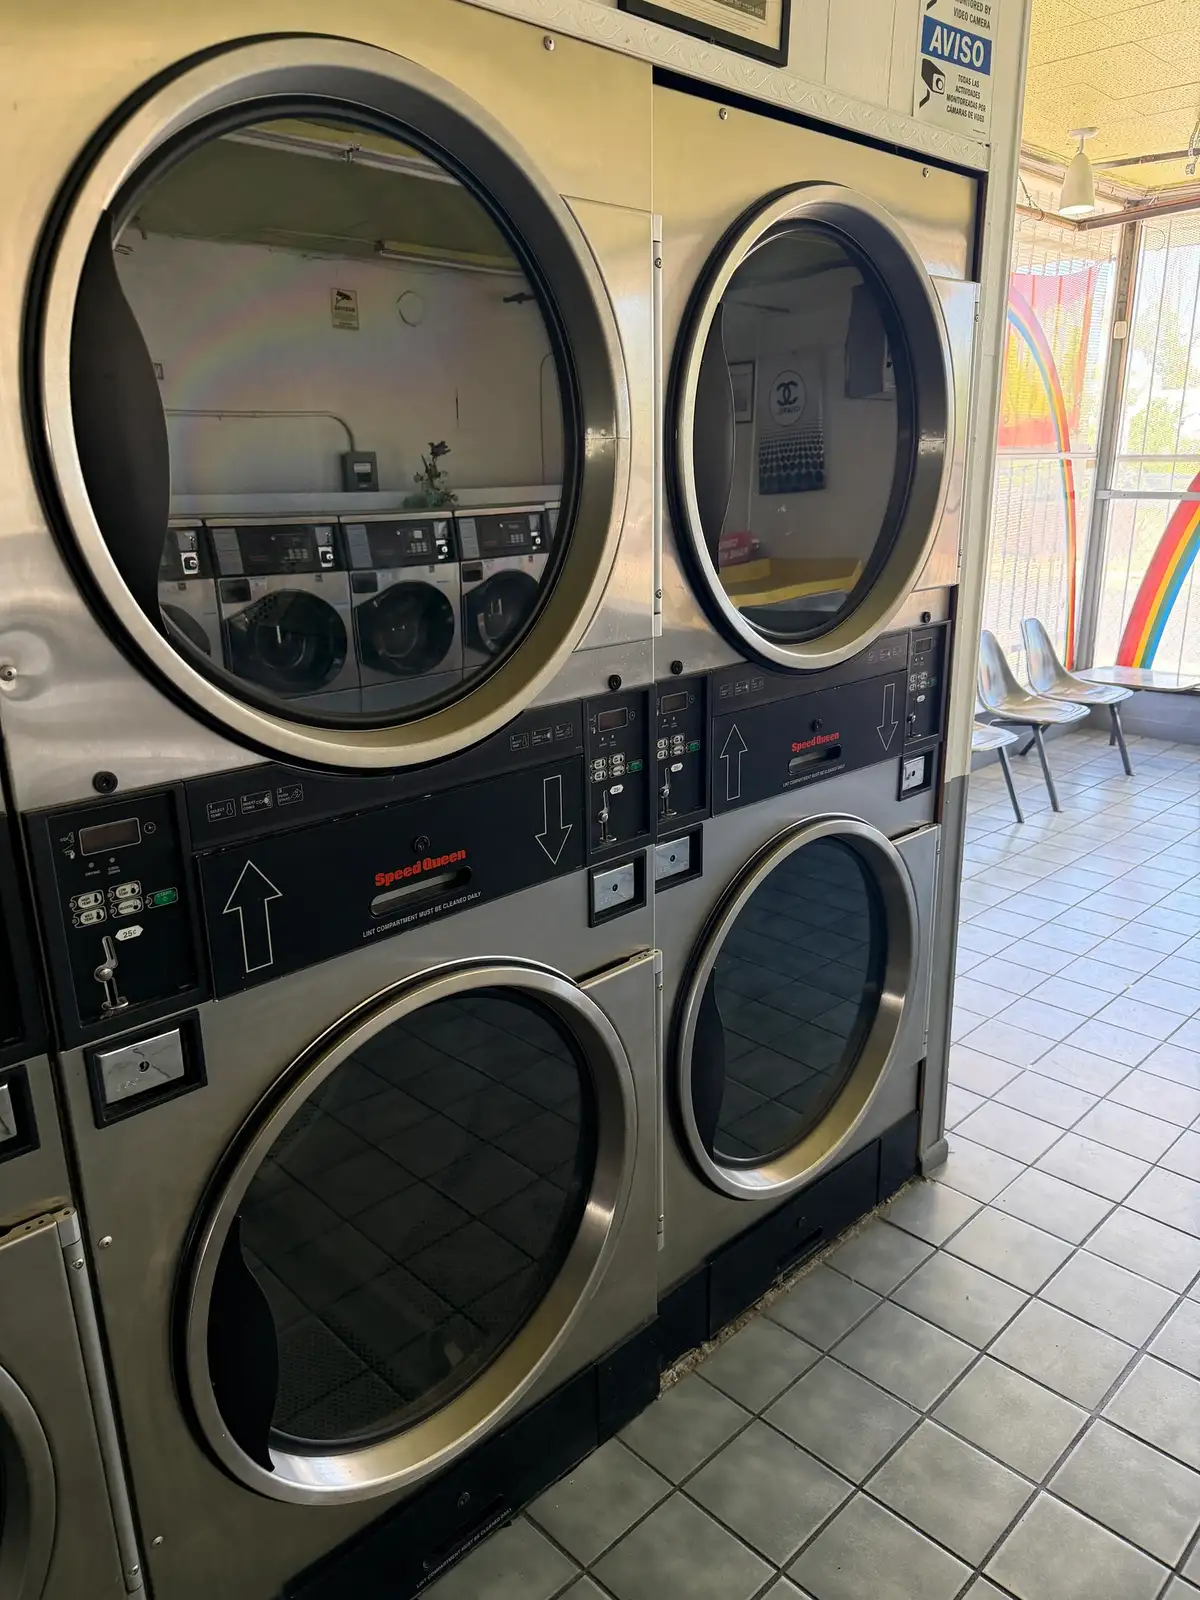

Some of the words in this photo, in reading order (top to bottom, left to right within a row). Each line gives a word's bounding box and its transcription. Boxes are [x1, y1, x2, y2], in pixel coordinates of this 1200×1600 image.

[954, 6, 968, 21] VIDEO
[970, 14, 990, 30] CAMERA
[984, 4, 992, 15] BY
[929, 25, 984, 68] AVISO
[958, 74, 971, 86] TODAS
[972, 80, 980, 88] LAS
[955, 85, 980, 100] ACTIVIDADES
[946, 94, 978, 110] MONITOREADAS
[978, 104, 986, 112] POR
[946, 104, 967, 117] CÁMARAS
[968, 110, 974, 120] DE
[792, 737, 816, 752] Speed
[816, 732, 840, 744] Queen
[375, 860, 422, 886] Speed
[422, 850, 466, 870] Queen
[362, 928, 376, 938] LINT
[376, 913, 418, 933] COMPARTMENT
[418, 908, 434, 918] MUST
[442, 896, 467, 909] CLEANED
[467, 890, 482, 901] DAILY
